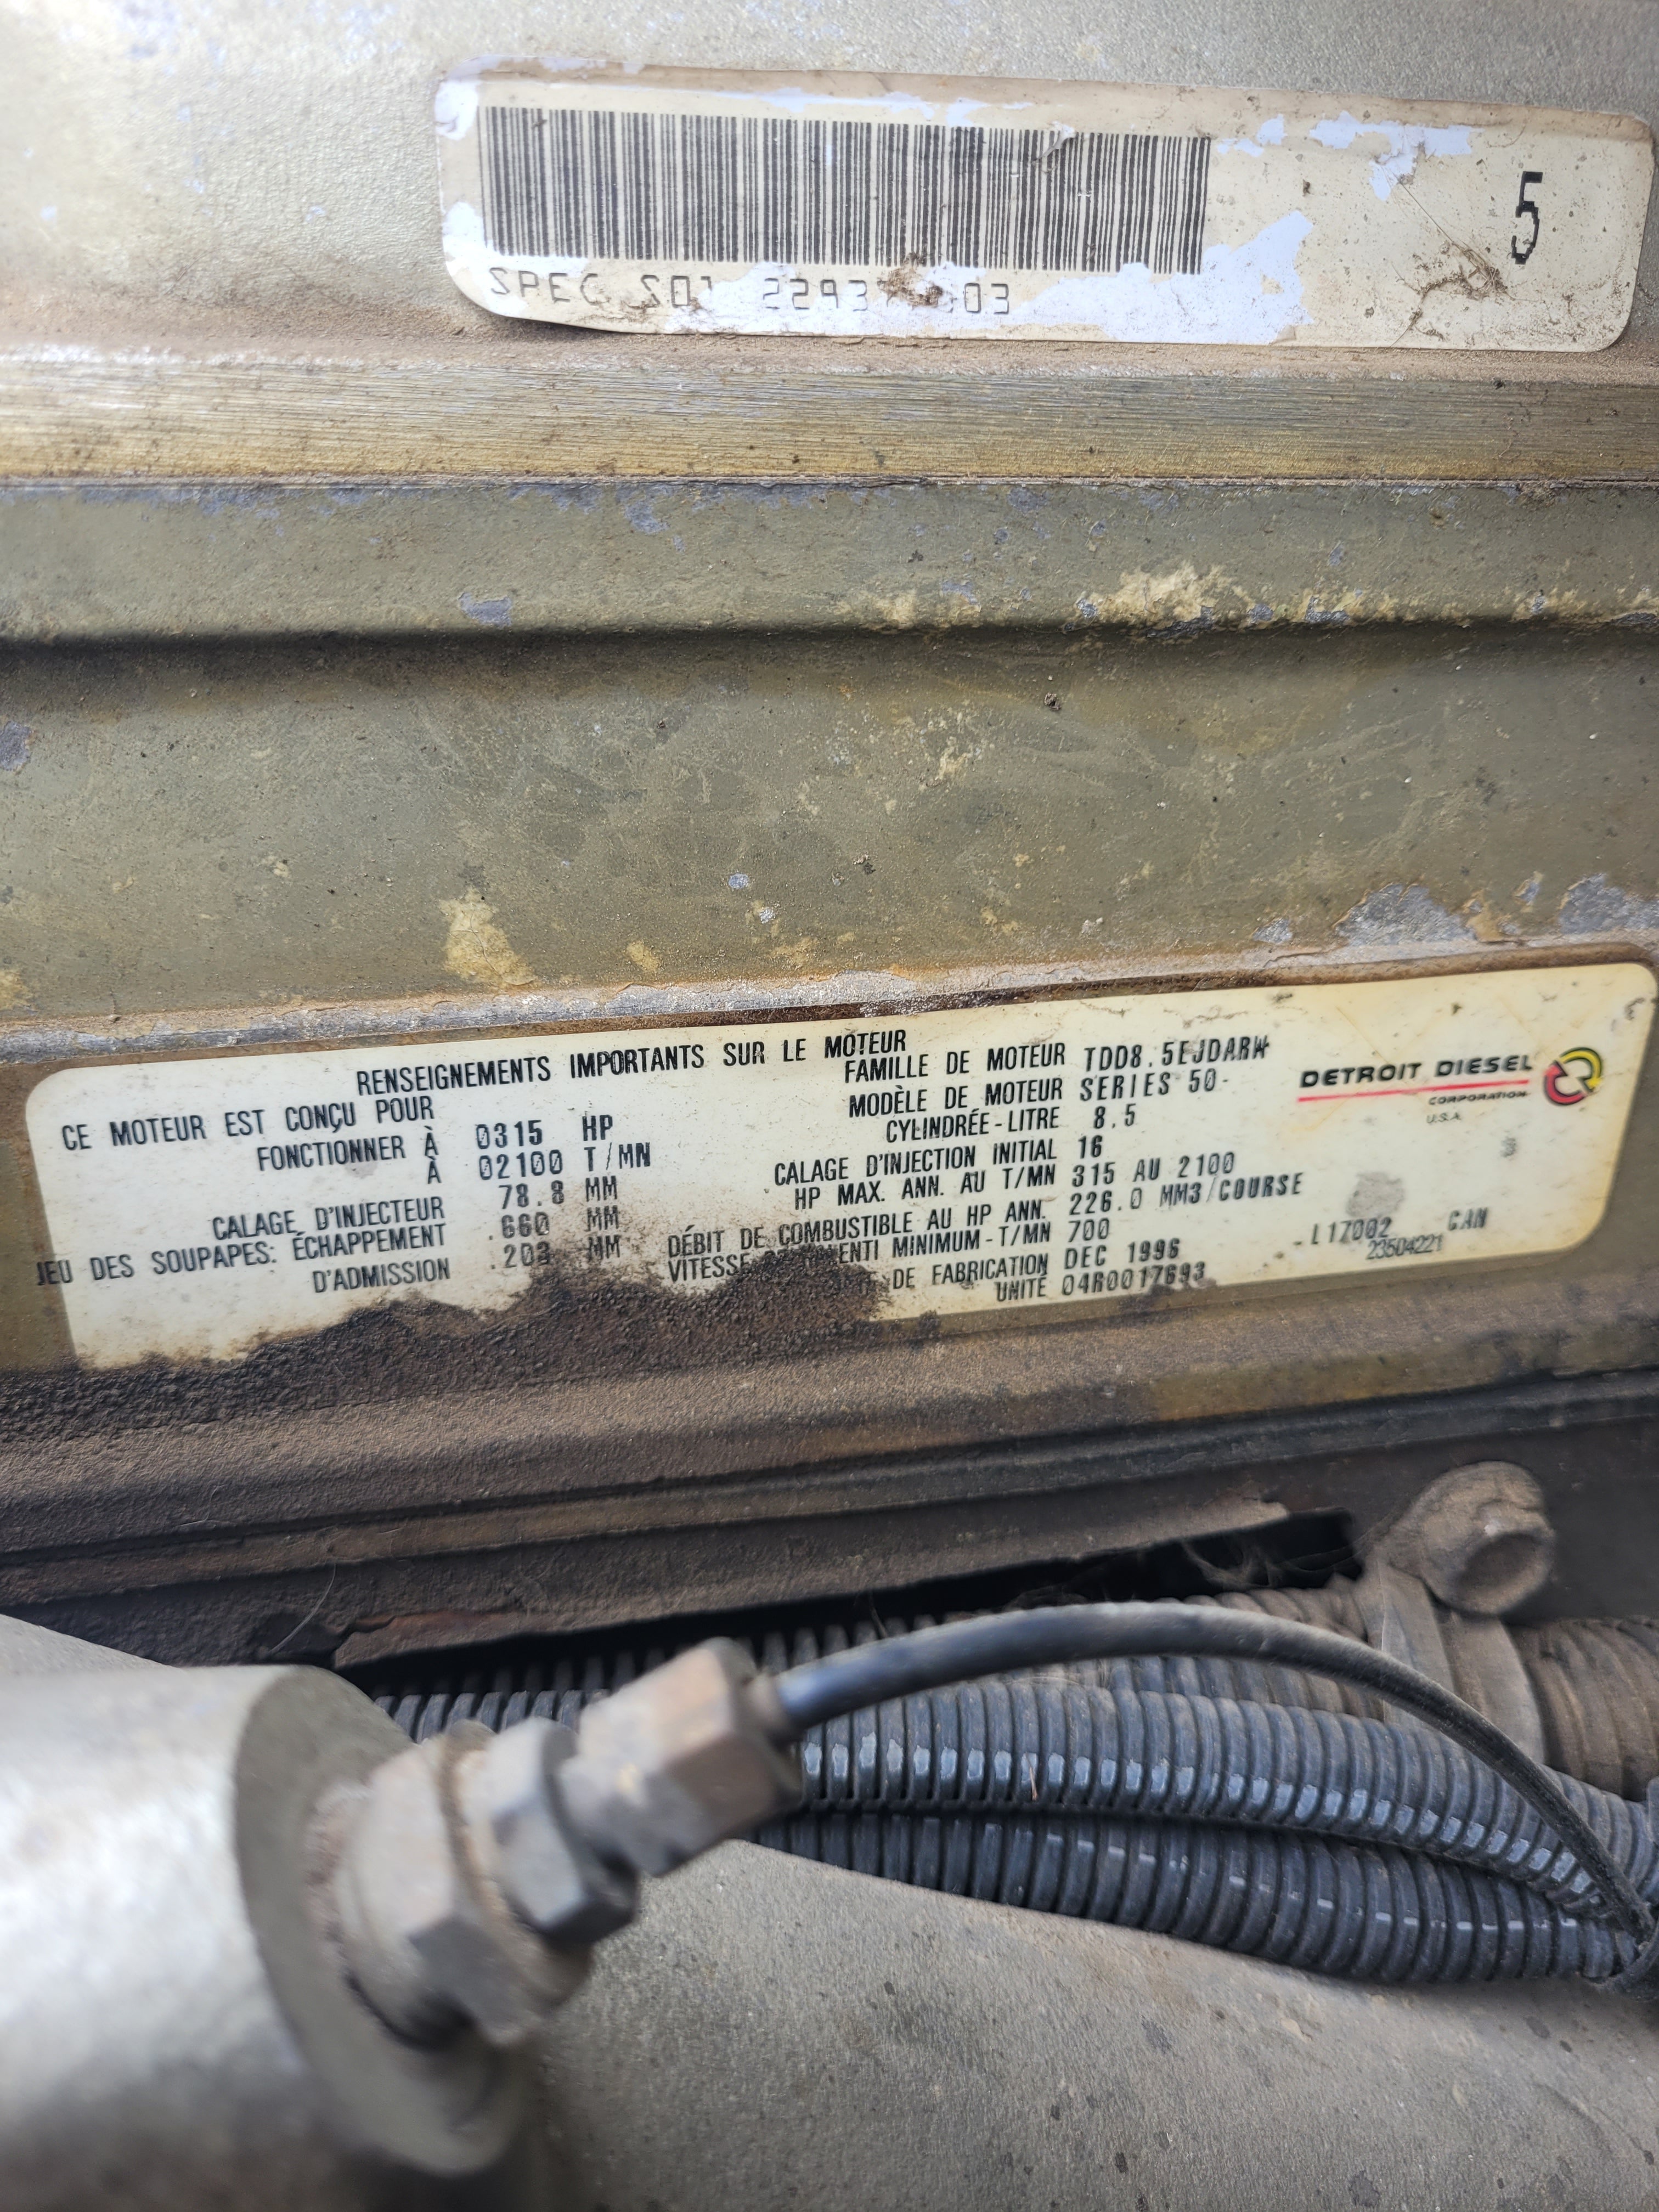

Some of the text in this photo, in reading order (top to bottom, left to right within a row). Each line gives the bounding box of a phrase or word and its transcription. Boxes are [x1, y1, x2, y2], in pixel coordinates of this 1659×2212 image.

[1511, 171, 1543, 265] 5
[488, 267, 606, 305] SPEC
[357, 1029, 906, 1096] RENSEIGNEMENTS IMPORTANTS SUR LE MOTEUR
[844, 1053, 930, 1084] FAMILLE
[946, 1050, 970, 1075] DE
[986, 1042, 1065, 1072] MOTEUR
[1300, 1054, 1533, 1088] DETROIT DIESEL
[848, 1085, 928, 1118] MODÈLE
[944, 1085, 969, 1110] DE
[984, 1076, 1063, 1105] MOTEUR
[1079, 1071, 1170, 1102] SERIES
[1093, 1103, 1137, 1130] 8.5
[1428, 1091, 1528, 1106] CORPORATION
[61, 1094, 435, 1151] CE MOTEUR EST CONÇU POUR
[257, 1114, 614, 1171] FONCTIONNER À 0315 HP
[426, 1142, 652, 1185] À 02100 T/MN
[774, 1135, 1103, 1186] CALAGE D'INJECTION INITIAL 16
[794, 1151, 1235, 1210] HP MAX. ANN. AU T/MN 315 AU 2100
[212, 1175, 618, 1241] CALAGE D'INJECTEUR 78.8 MM
[667, 1171, 1305, 1258] DÉBIT DE COMBUSTIBLE AU HP ANN. 226.0 MM3/COURSE
[1066, 1218, 1110, 1243] 700
[1447, 1206, 1489, 1231] CAN
[36, 1259, 74, 1286] JEU
[89, 1254, 135, 1280] DES
[151, 1240, 277, 1275] SOUPAPES:
[292, 1223, 446, 1261] ÉCHAPPEMENT
[585, 1205, 620, 1232] MM
[313, 1257, 450, 1294] D'ADMISSION
[587, 1234, 621, 1262] MM
[892, 1237, 1181, 1290] DE FABRICATION DEC 1996
